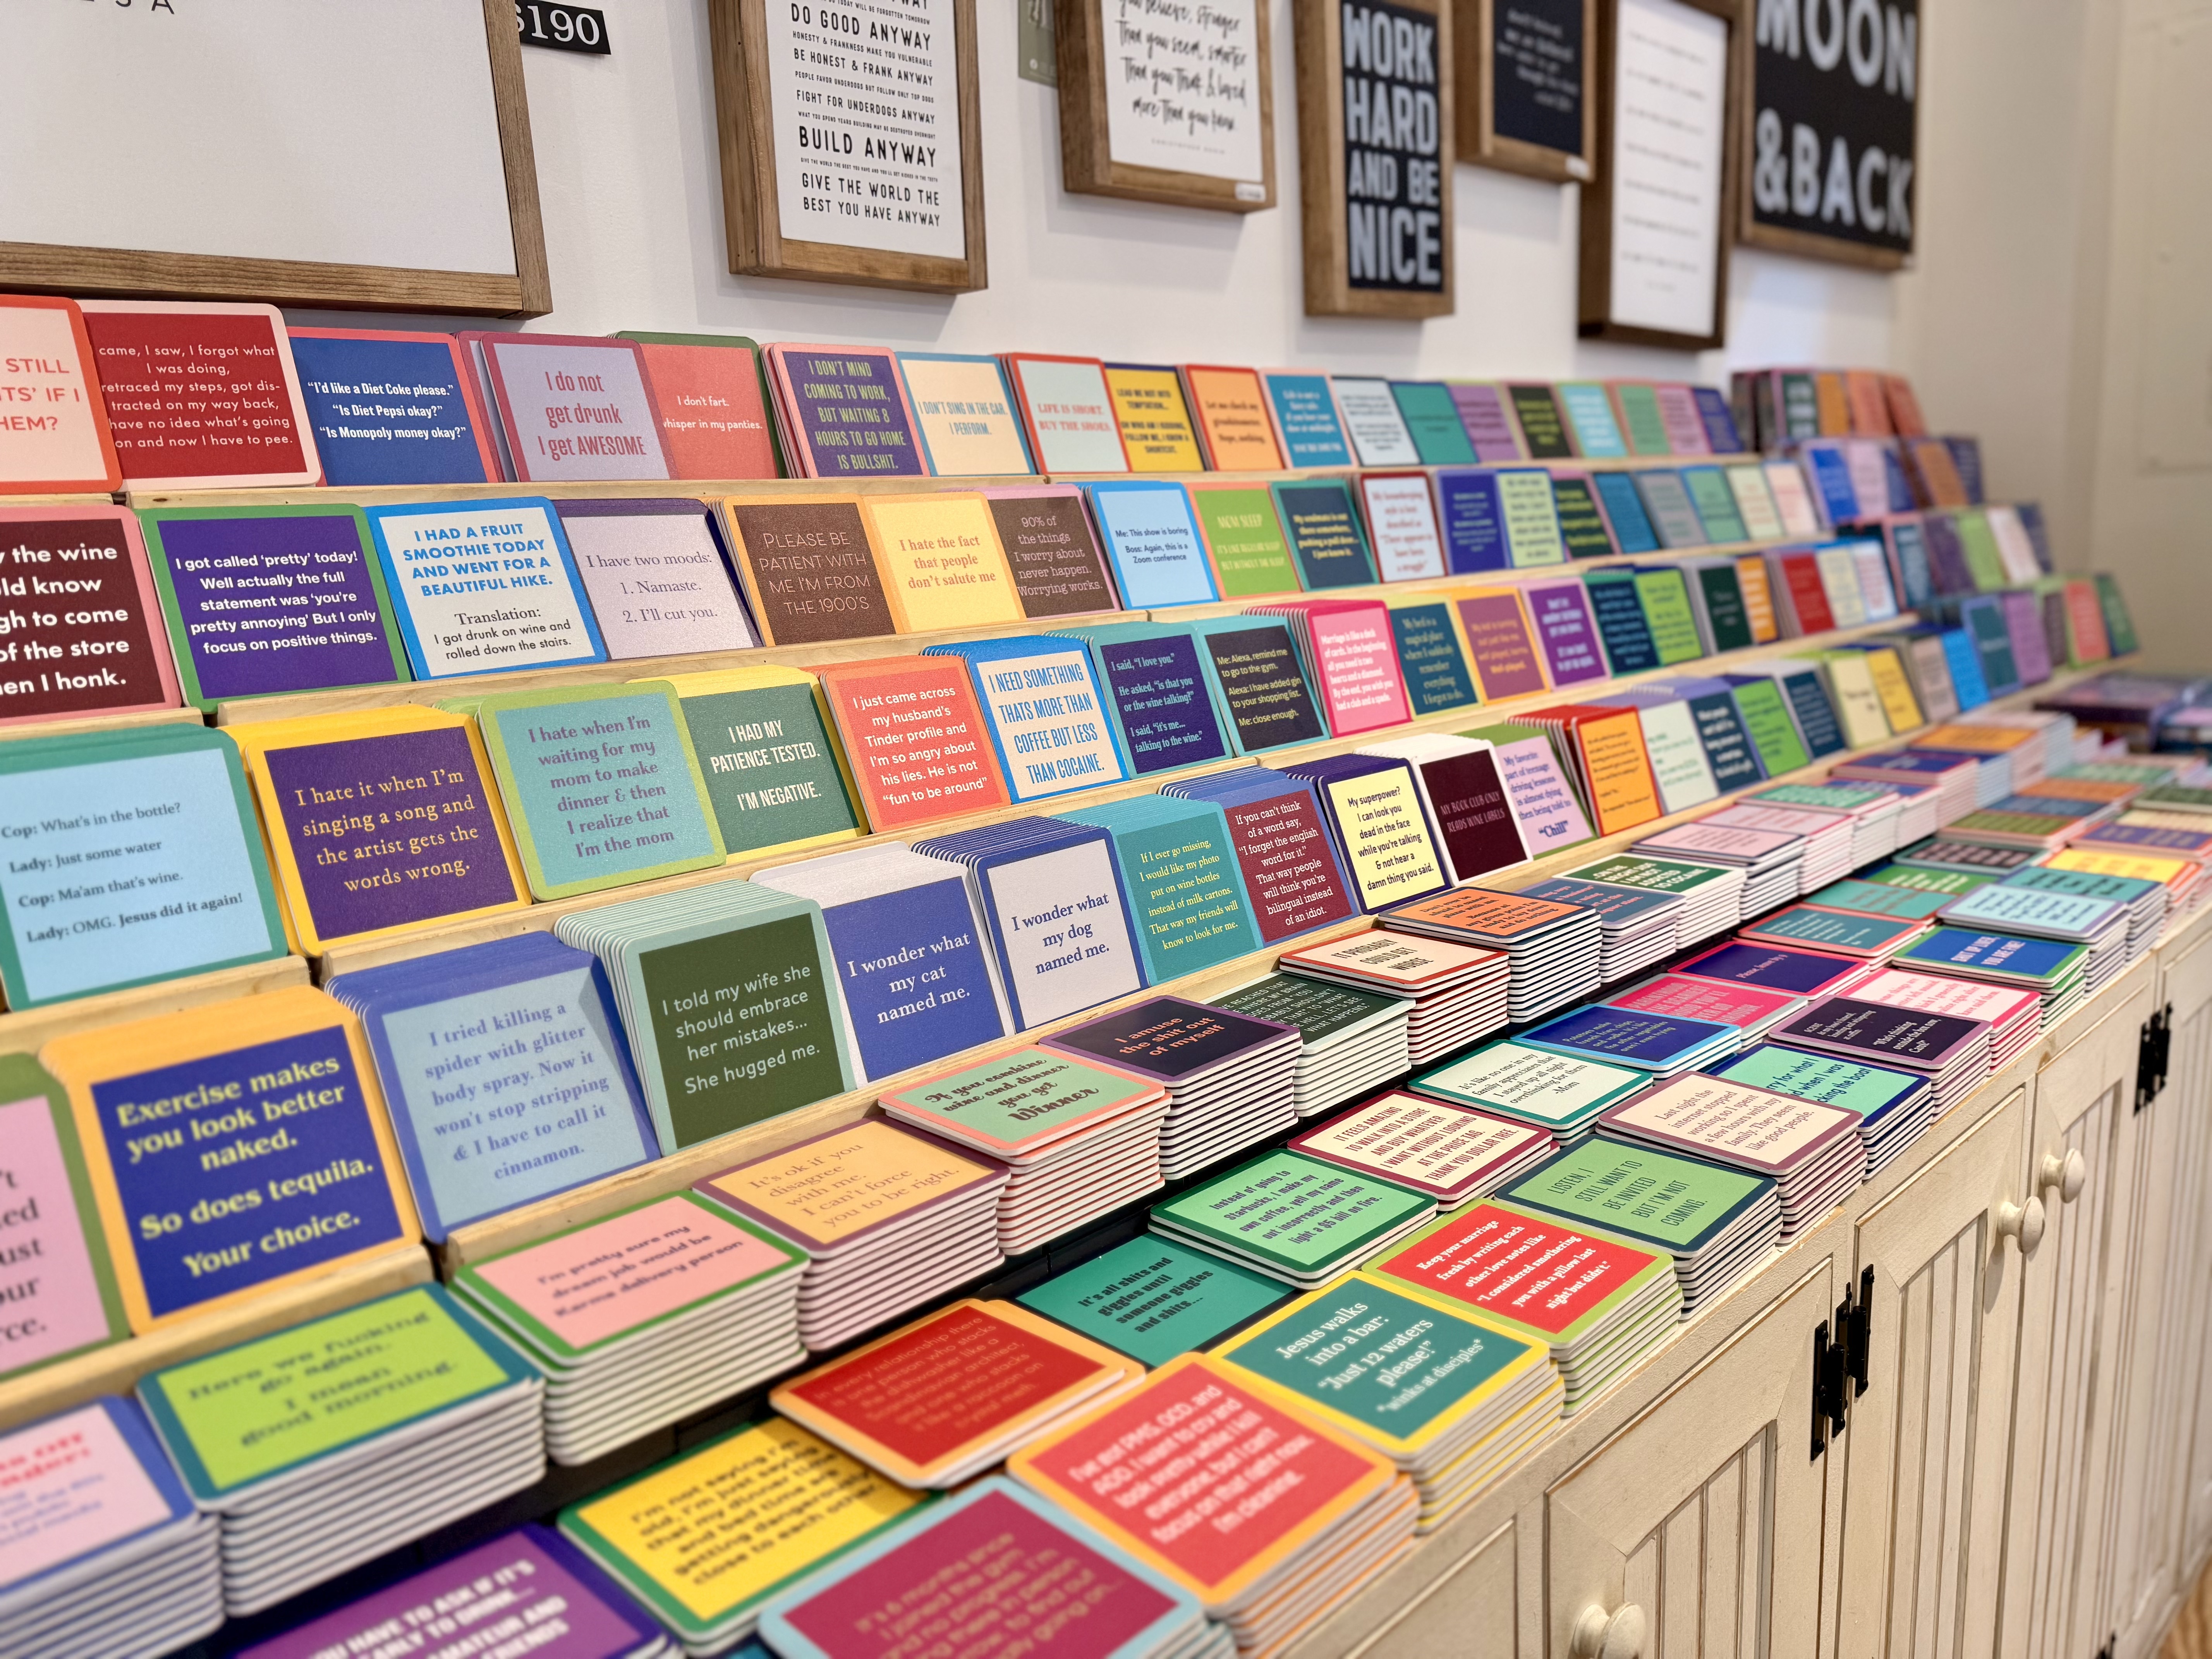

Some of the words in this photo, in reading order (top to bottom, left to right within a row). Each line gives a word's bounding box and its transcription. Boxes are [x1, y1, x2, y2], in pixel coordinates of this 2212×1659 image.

[791, 3, 811, 25] DO
[820, 10, 860, 36] GOOD
[870, 21, 931, 50] ANYWAY
[793, 31, 819, 43] HONESTY
[823, 37, 827, 45] &
[830, 38, 864, 53] FRANKNESS
[867, 47, 882, 57] MAKE
[885, 50, 895, 59] YOU
[898, 53, 932, 67] VULNERABLE
[1343, 2, 1434, 84] WORK
[1345, 76, 1437, 155] HARD
[799, 125, 853, 155] BUILD
[865, 137, 936, 167] ANYWAY
[1349, 149, 1397, 201] AND
[1407, 157, 1439, 207] BE
[803, 196, 831, 213] BEST
[838, 201, 859, 216] YOU
[865, 205, 891, 221] HAVE
[898, 210, 940, 226] ANYWAY
[1349, 201, 1441, 285] NICE
[146, 363, 151, 373] I
[187, 362, 230, 376] doing,
[545, 371, 553, 391] I
[555, 371, 575, 391] do
[577, 375, 605, 392] not
[112, 398, 161, 410] tracted
[187, 402, 206, 412] my
[211, 402, 239, 412] way
[242, 397, 279, 410] back,
[545, 405, 573, 428] get
[574, 403, 623, 423] drunk
[918, 401, 923, 414] I
[946, 402, 966, 415] SING
[965, 402, 976, 415] IN
[975, 402, 990, 415] THE
[989, 403, 1008, 415] CAR.
[338, 426, 392, 441] Monopoly
[394, 429, 429, 440] money
[949, 422, 954, 435] I
[953, 422, 992, 435] PERFORM.
[538, 436, 546, 455] I
[548, 438, 576, 460] get
[577, 436, 647, 455] AWESOME
[899, 539, 906, 551] I
[908, 539, 935, 551] hate
[937, 537, 956, 548] the
[958, 535, 981, 547] fact
[1018, 534, 1036, 544] the
[1037, 533, 1071, 544] things
[1167, 527, 1188, 536] boring
[403, 543, 491, 561] SMOOTHIE
[493, 539, 544, 553] TODAY
[586, 555, 595, 568] I
[596, 555, 631, 567] have
[634, 556, 660, 565] two
[664, 551, 712, 564] moods:
[200, 577, 234, 589] Well
[237, 574, 293, 588] actually
[296, 573, 320, 584] the
[322, 571, 345, 583] full
[421, 578, 508, 596] BEAUTIFUL
[510, 574, 553, 587] HIKE.
[620, 582, 634, 594] 1.
[636, 580, 701, 593] Namaste.
[454, 607, 541, 625] Translation:
[988, 675, 996, 693] I
[995, 671, 1024, 692] NEED
[1023, 663, 1084, 688] SOMETHING
[1230, 669, 1240, 677] go
[1248, 665, 1261, 673] the
[1261, 663, 1278, 673] gym.
[864, 733, 903, 747] Tinder
[907, 726, 943, 744] profile
[946, 722, 967, 735] and
[710, 749, 771, 773] PATIENCE
[769, 742, 820, 763] TESTED.
[550, 774, 591, 789] mom
[595, 769, 612, 781] to
[617, 761, 658, 778] make
[1347, 797, 1359, 808] My
[1359, 786, 1400, 805] superpower?
[9, 857, 52, 873] Lady:
[55, 853, 82, 868] Just
[85, 848, 122, 861] some
[125, 842, 162, 854] water
[1139, 872, 1145, 882] I
[1145, 865, 1170, 880] would
[1169, 863, 1185, 874] like
[1185, 861, 1197, 870] my
[1198, 855, 1220, 868] photo
[344, 868, 402, 891] words
[405, 860, 470, 880] wrong.
[1011, 916, 1020, 931] I
[1022, 904, 1073, 927] wonder
[1076, 893, 1109, 912] what
[1042, 932, 1064, 947] my
[1068, 924, 1093, 939] dog
[1341, 939, 1398, 955] PROBABLY
[1035, 946, 1083, 974] named
[1085, 944, 1109, 958] me.
[1360, 953, 1400, 964] COULD
[1388, 957, 1434, 970] WORSE
[687, 1042, 718, 1061] her
[723, 1020, 807, 1051] mistakes...
[1120, 1042, 1151, 1053] the
[1152, 1029, 1186, 1042] shit
[1186, 1017, 1215, 1029] out
[1149, 1046, 1169, 1055] of
[1169, 1024, 1225, 1047] myself
[425, 1054, 481, 1080] spider
[488, 1039, 527, 1060] with
[533, 1027, 585, 1053] glitter
[118, 1083, 240, 1126] Exercise
[250, 1058, 340, 1092] makes
[1654, 1109, 1680, 1119] Last
[1676, 1097, 1701, 1110] night
[1695, 1090, 1713, 1098] the
[1745, 1140, 1769, 1150] like
[1765, 1127, 1788, 1141] good
[1784, 1111, 1815, 1129] people.
[1425, 1163, 1459, 1180] THANK
[1450, 1154, 1474, 1165] YOU
[1465, 1139, 1501, 1156] DOLLAR
[1494, 1130, 1519, 1140] TREE.
[1547, 1173, 1587, 1193] LISTEN,
[1602, 1199, 1626, 1210] BE
[1617, 1177, 1656, 1201] INVITED
[1661, 1199, 1708, 1226] COMING.
[184, 1243, 251, 1276] Your
[260, 1212, 360, 1252] choice.
[1098, 1290, 1144, 1316] giggles
[1142, 1274, 1173, 1291] until
[1276, 1329, 1325, 1358] Jesus
[1320, 1303, 1368, 1330] walks
